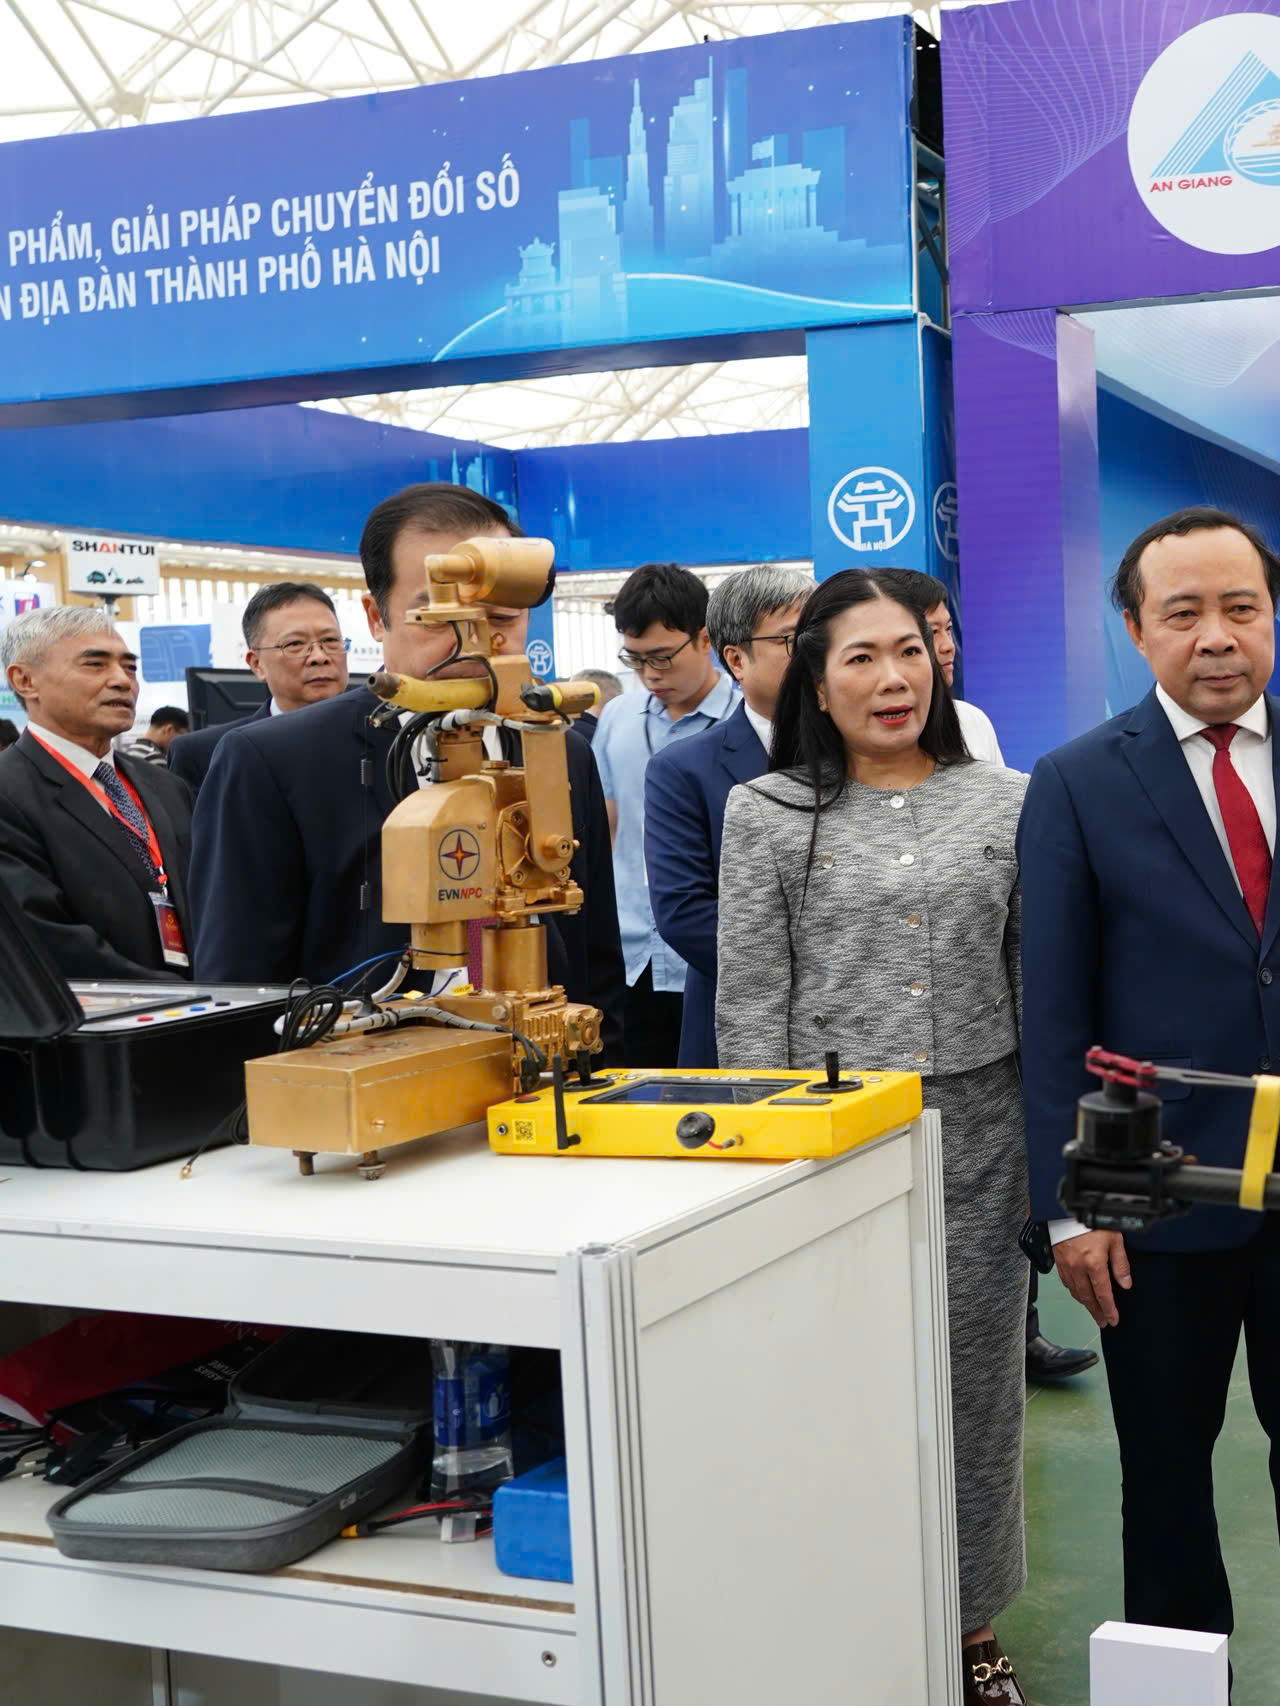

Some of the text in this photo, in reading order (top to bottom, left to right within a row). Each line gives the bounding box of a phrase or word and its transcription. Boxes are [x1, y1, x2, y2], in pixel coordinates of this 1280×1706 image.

[1149, 175, 1233, 193] AN GIANG
[8, 152, 520, 268] PHẨM, GIẢI PHÁP CHUYỂN ĐỔI SỐ
[19, 279, 71, 326] ĐỊA
[78, 265, 137, 313] BÀN
[145, 255, 248, 306] THÀNH
[257, 235, 322, 294] PHỐ
[332, 235, 377, 286] HÀ
[385, 229, 440, 286] NỘI
[71, 539, 156, 557] SHANTUI
[437, 887, 483, 902] EVNNPC
